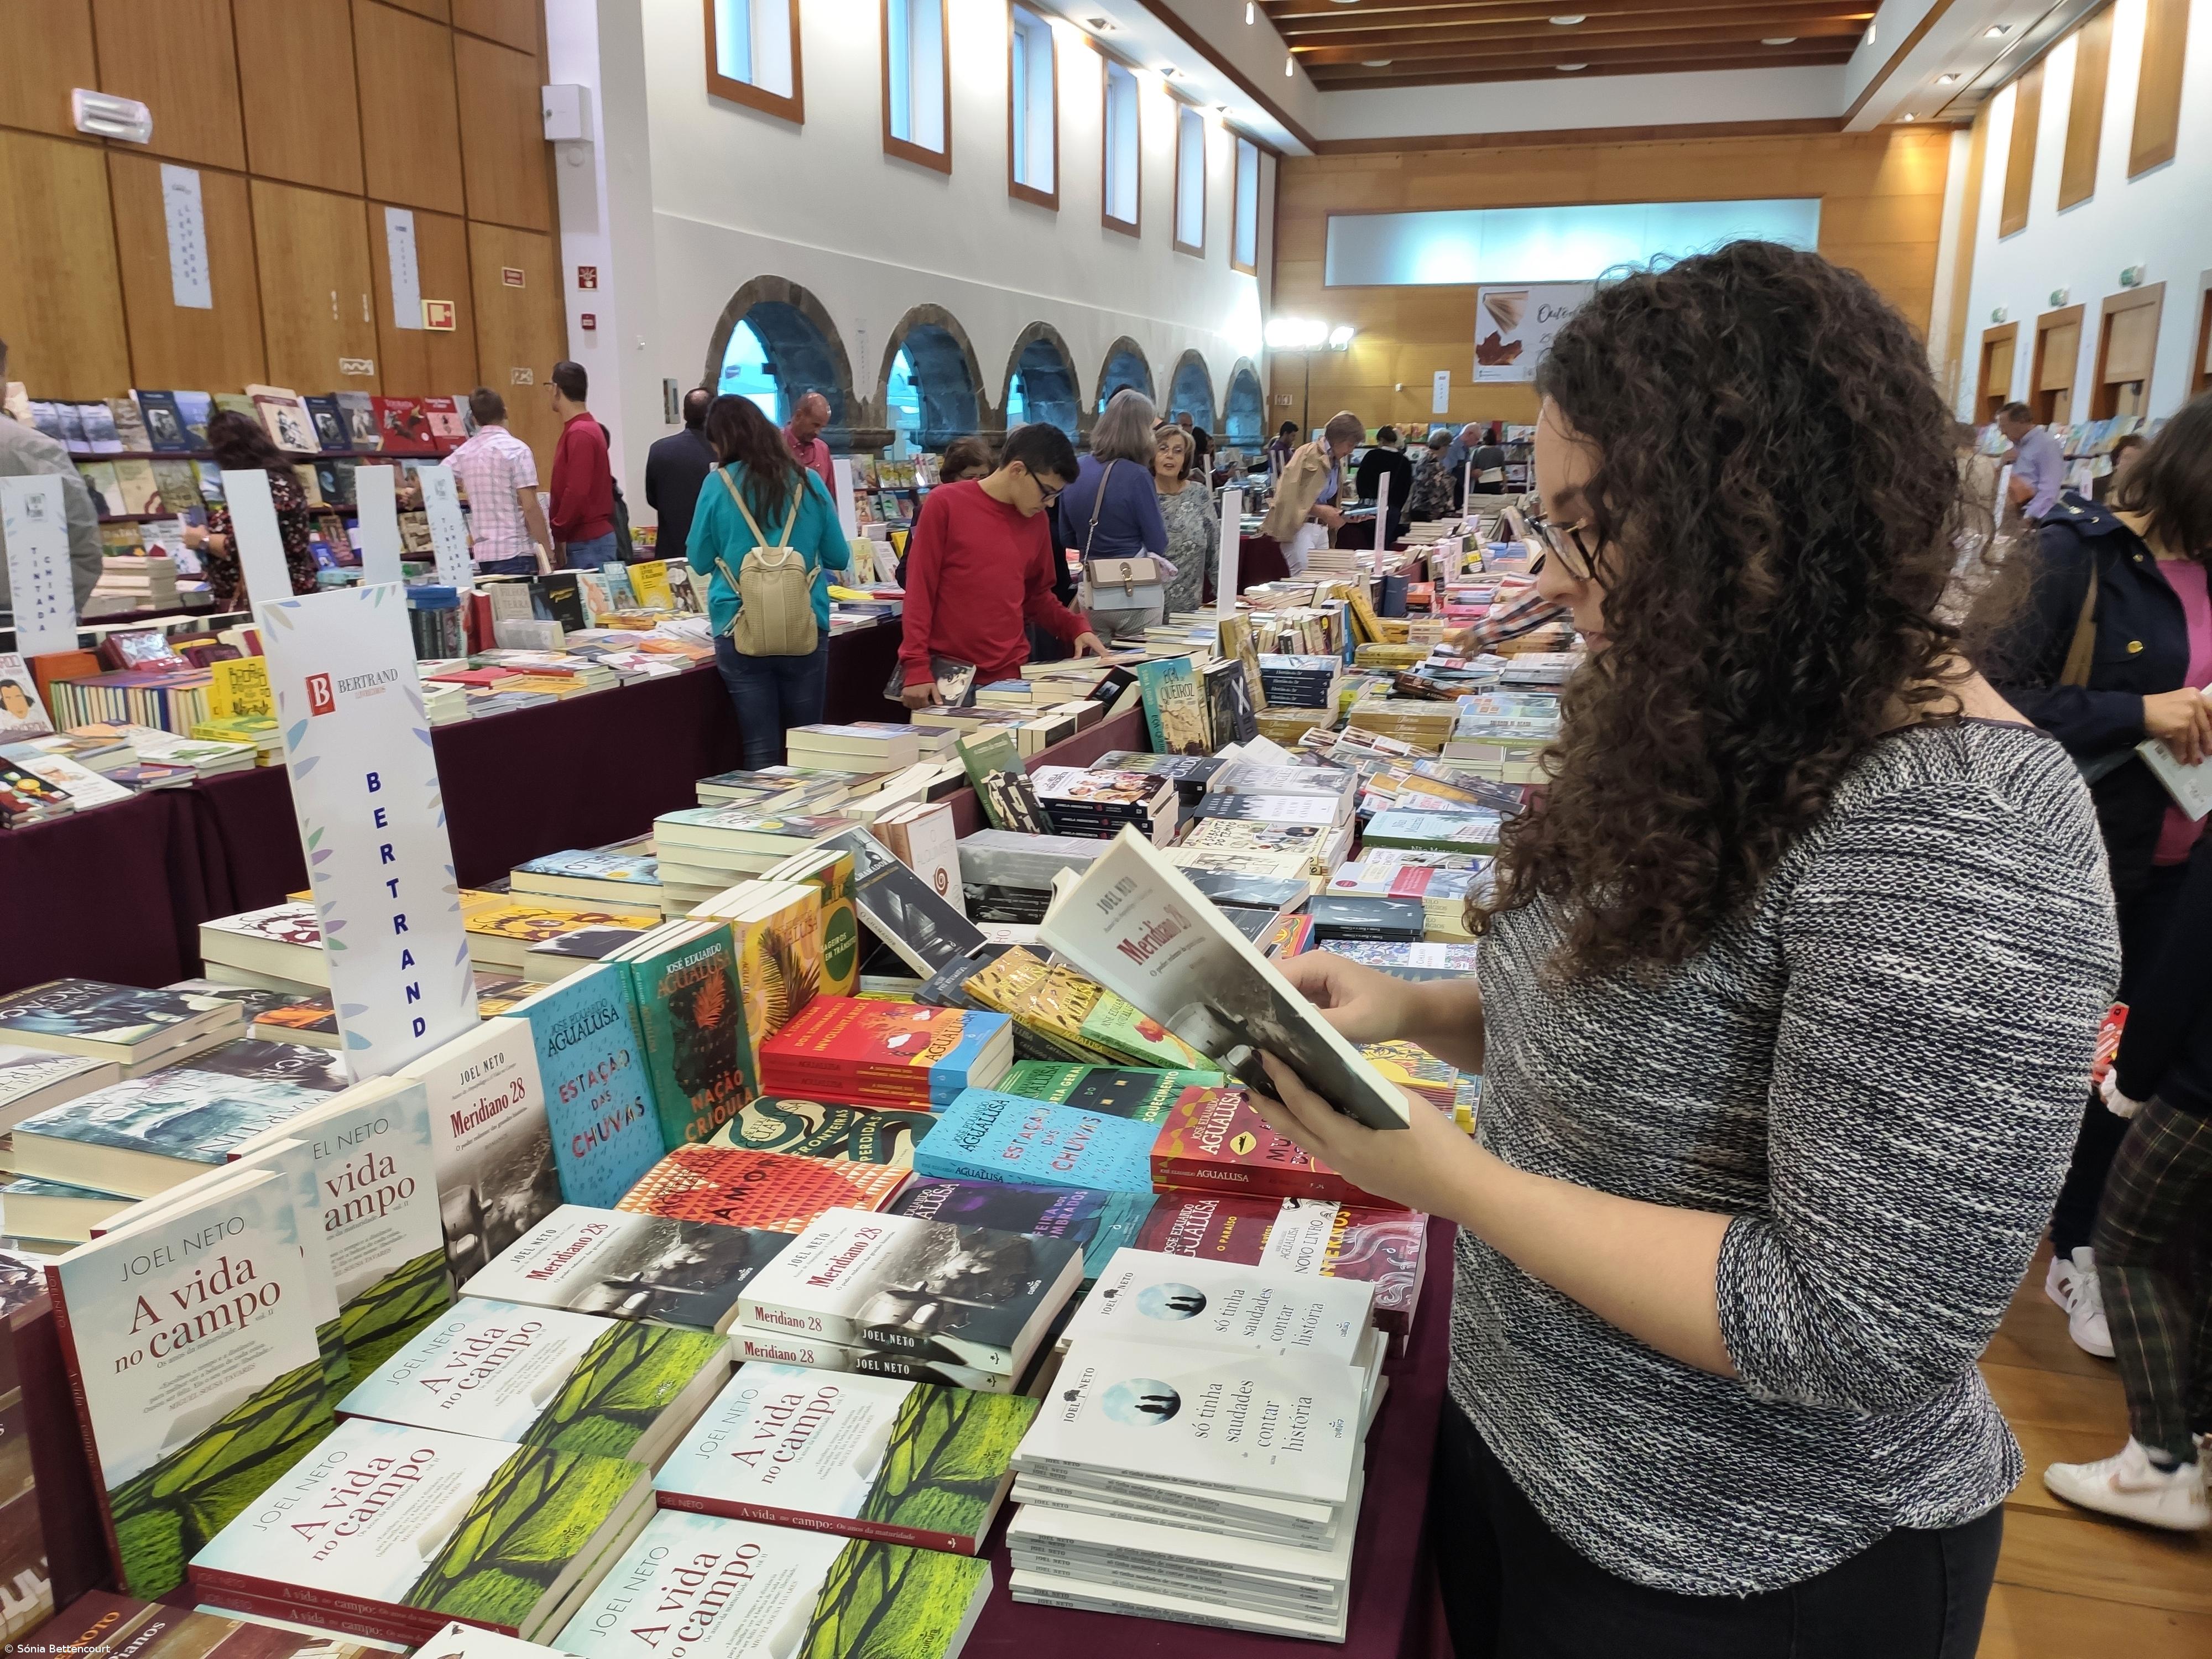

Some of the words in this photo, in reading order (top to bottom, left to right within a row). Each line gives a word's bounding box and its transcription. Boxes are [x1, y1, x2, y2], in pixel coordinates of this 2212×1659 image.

[338, 668, 398, 693] BERTRAND
[657, 950, 732, 1000] AGUALUSA
[666, 958, 684, 974] JOSÉ
[684, 942, 722, 966] EDUARDO
[547, 1004, 620, 1057] AGUALUSA
[792, 1006, 822, 1032] SOCIEDADE
[806, 1002, 846, 1039] SONHADORES
[812, 1001, 871, 1052] INVOLUNTÁRIOS
[924, 1013, 978, 1062] AGUALUSA
[460, 1065, 481, 1085] JOEL
[483, 1052, 504, 1073] NETO
[559, 1049, 631, 1104] ESTAÇÃO
[691, 1070, 744, 1113] NAÇÃO
[1061, 1066, 1084, 1087] GERAL
[1083, 1087, 1097, 1095] DO
[450, 1094, 509, 1138] Meridiano
[510, 1077, 525, 1104] 28
[591, 1090, 613, 1112] DAS
[685, 1091, 753, 1142] CRIOULA
[962, 1100, 990, 1130] EDUARDO
[1142, 1071, 1180, 1123] SQUECIMENTO
[1190, 1127, 1204, 1140] JOSÉ
[1200, 1097, 1219, 1128] EDUARDO
[337, 1118, 389, 1151] NETO
[571, 1095, 646, 1159] CHUVAS
[791, 1109, 848, 1156] FRONTEIRAS
[859, 1116, 883, 1161] PERDIDAS
[959, 1099, 1010, 1152] AGUALUSA
[1001, 1107, 1052, 1161] ESTAÇÃO
[1040, 1129, 1061, 1146] DAS
[1051, 1115, 1103, 1171] CHUVAS
[1198, 1092, 1241, 1155] AGUALUSA
[324, 1152, 397, 1198] vida
[954, 1166, 1004, 1183] AGUALUSA
[1196, 1169, 1249, 1183] AGUALUSA
[325, 1176, 415, 1232] ampo
[1056, 1196, 1066, 1208] DOS
[1176, 1203, 1195, 1235] EDUARDO
[121, 1245, 175, 1282] JOEL
[182, 1216, 245, 1256] NETO
[509, 1246, 536, 1264] JOEL
[531, 1228, 557, 1246] NETO
[524, 1235, 593, 1282] Meridiano
[587, 1223, 609, 1237] 28
[787, 1251, 812, 1267] JOEL
[805, 1233, 830, 1249] NETO
[1219, 1215, 1238, 1245] PARAÍSO
[1279, 1227, 1300, 1260] AGUALUSA
[1293, 1245, 1308, 1274] NOVO
[1301, 1219, 1324, 1246] LIVRO
[805, 1241, 869, 1288] Meridiano
[854, 1227, 883, 1240] 28
[128, 1295, 163, 1335] A
[169, 1255, 258, 1311] vida
[1100, 1296, 1118, 1316] JOEL
[1118, 1271, 1134, 1291] NETO
[1219, 1289, 1245, 1316] tinha
[1243, 1287, 1274, 1337] saudades
[114, 1349, 143, 1374] no
[149, 1281, 280, 1358] campo
[754, 1305, 806, 1330] Meridiano
[807, 1316, 823, 1332] 28
[862, 1328, 886, 1343] JOEL
[889, 1334, 915, 1349] NETO
[1215, 1319, 1230, 1333] só
[1270, 1304, 1295, 1342] contar
[1291, 1303, 1326, 1346] história
[386, 1358, 427, 1385] JOEL
[426, 1322, 466, 1354] NETO
[419, 1376, 454, 1395] A
[445, 1327, 509, 1370] vida
[440, 1392, 462, 1410] no
[457, 1321, 542, 1390] campo
[743, 1340, 797, 1363] Meridiano
[799, 1350, 815, 1364] 28
[855, 1358, 881, 1371] JOEL
[883, 1360, 911, 1375] NETO
[1063, 1398, 1081, 1423] JOEL
[1079, 1366, 1096, 1390] NETO
[1196, 1383, 1223, 1418] tinha
[1226, 1380, 1255, 1443] saudades
[695, 1428, 731, 1460] JOEL
[721, 1389, 759, 1424] NETO
[730, 1448, 766, 1468] A
[752, 1394, 806, 1440] vida
[761, 1466, 781, 1484] no
[772, 1386, 839, 1463] campo
[1192, 1423, 1211, 1438] só
[1257, 1400, 1280, 1447] contar
[1281, 1396, 1313, 1452] história
[252, 1495, 301, 1532] JOEL
[296, 1451, 348, 1491] NETO
[290, 1520, 331, 1543] A
[320, 1457, 397, 1511] vida
[311, 1540, 338, 1562] no
[333, 1448, 435, 1536] campo
[678, 1499, 704, 1510] NETO
[740, 1507, 751, 1517] A
[752, 1510, 775, 1521] vida
[792, 1516, 833, 1529] campo:
[875, 1529, 916, 1541] maturidade
[589, 1597, 633, 1638] JOEL
[623, 1546, 669, 1592] NETO
[629, 1623, 672, 1650] A
[656, 1553, 723, 1614] vida
[677, 1542, 761, 1643] campo
